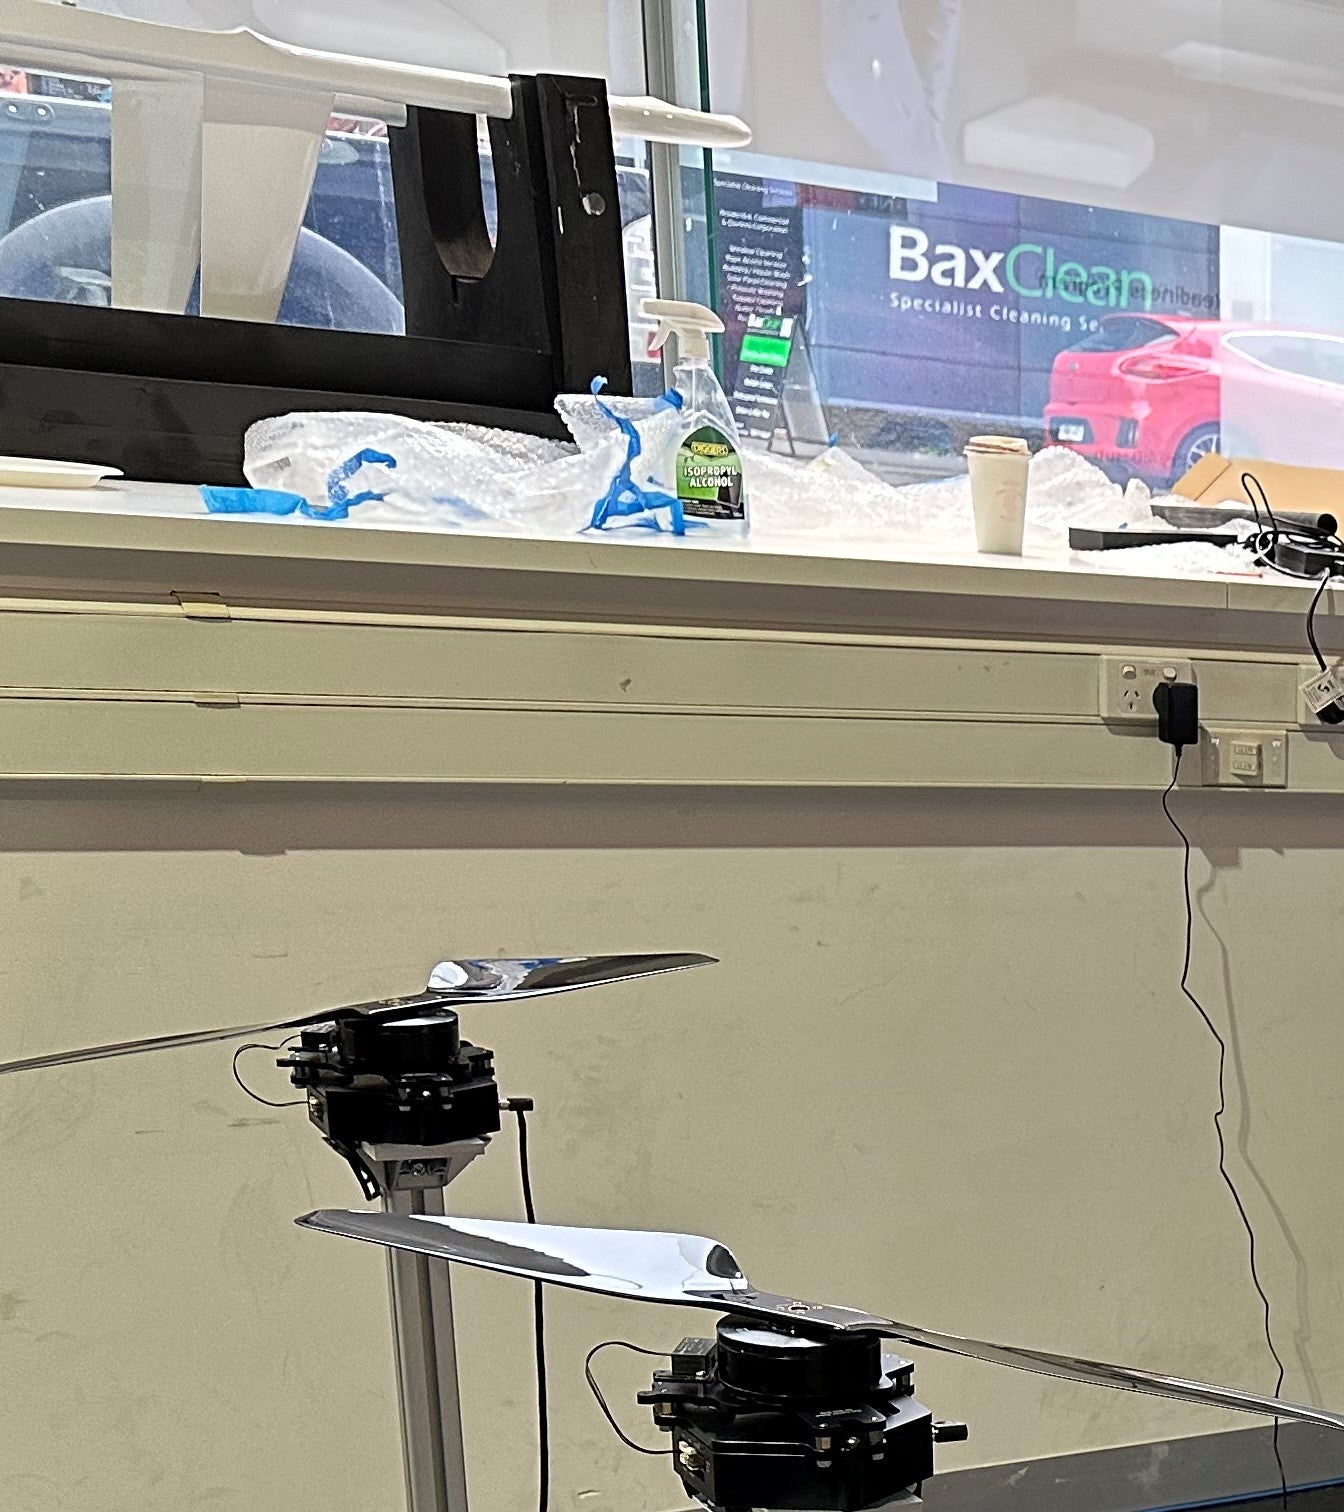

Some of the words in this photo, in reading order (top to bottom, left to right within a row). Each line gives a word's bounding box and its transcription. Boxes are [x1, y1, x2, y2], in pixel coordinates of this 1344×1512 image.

[889, 224, 1153, 311] BaxClean
[889, 291, 983, 319] Specialist
[989, 304, 1072, 333] Cleaning
[1079, 315, 1105, 333] Se
[684, 466, 737, 477] ISOPROPYL
[690, 476, 734, 488] ALCOHOL
